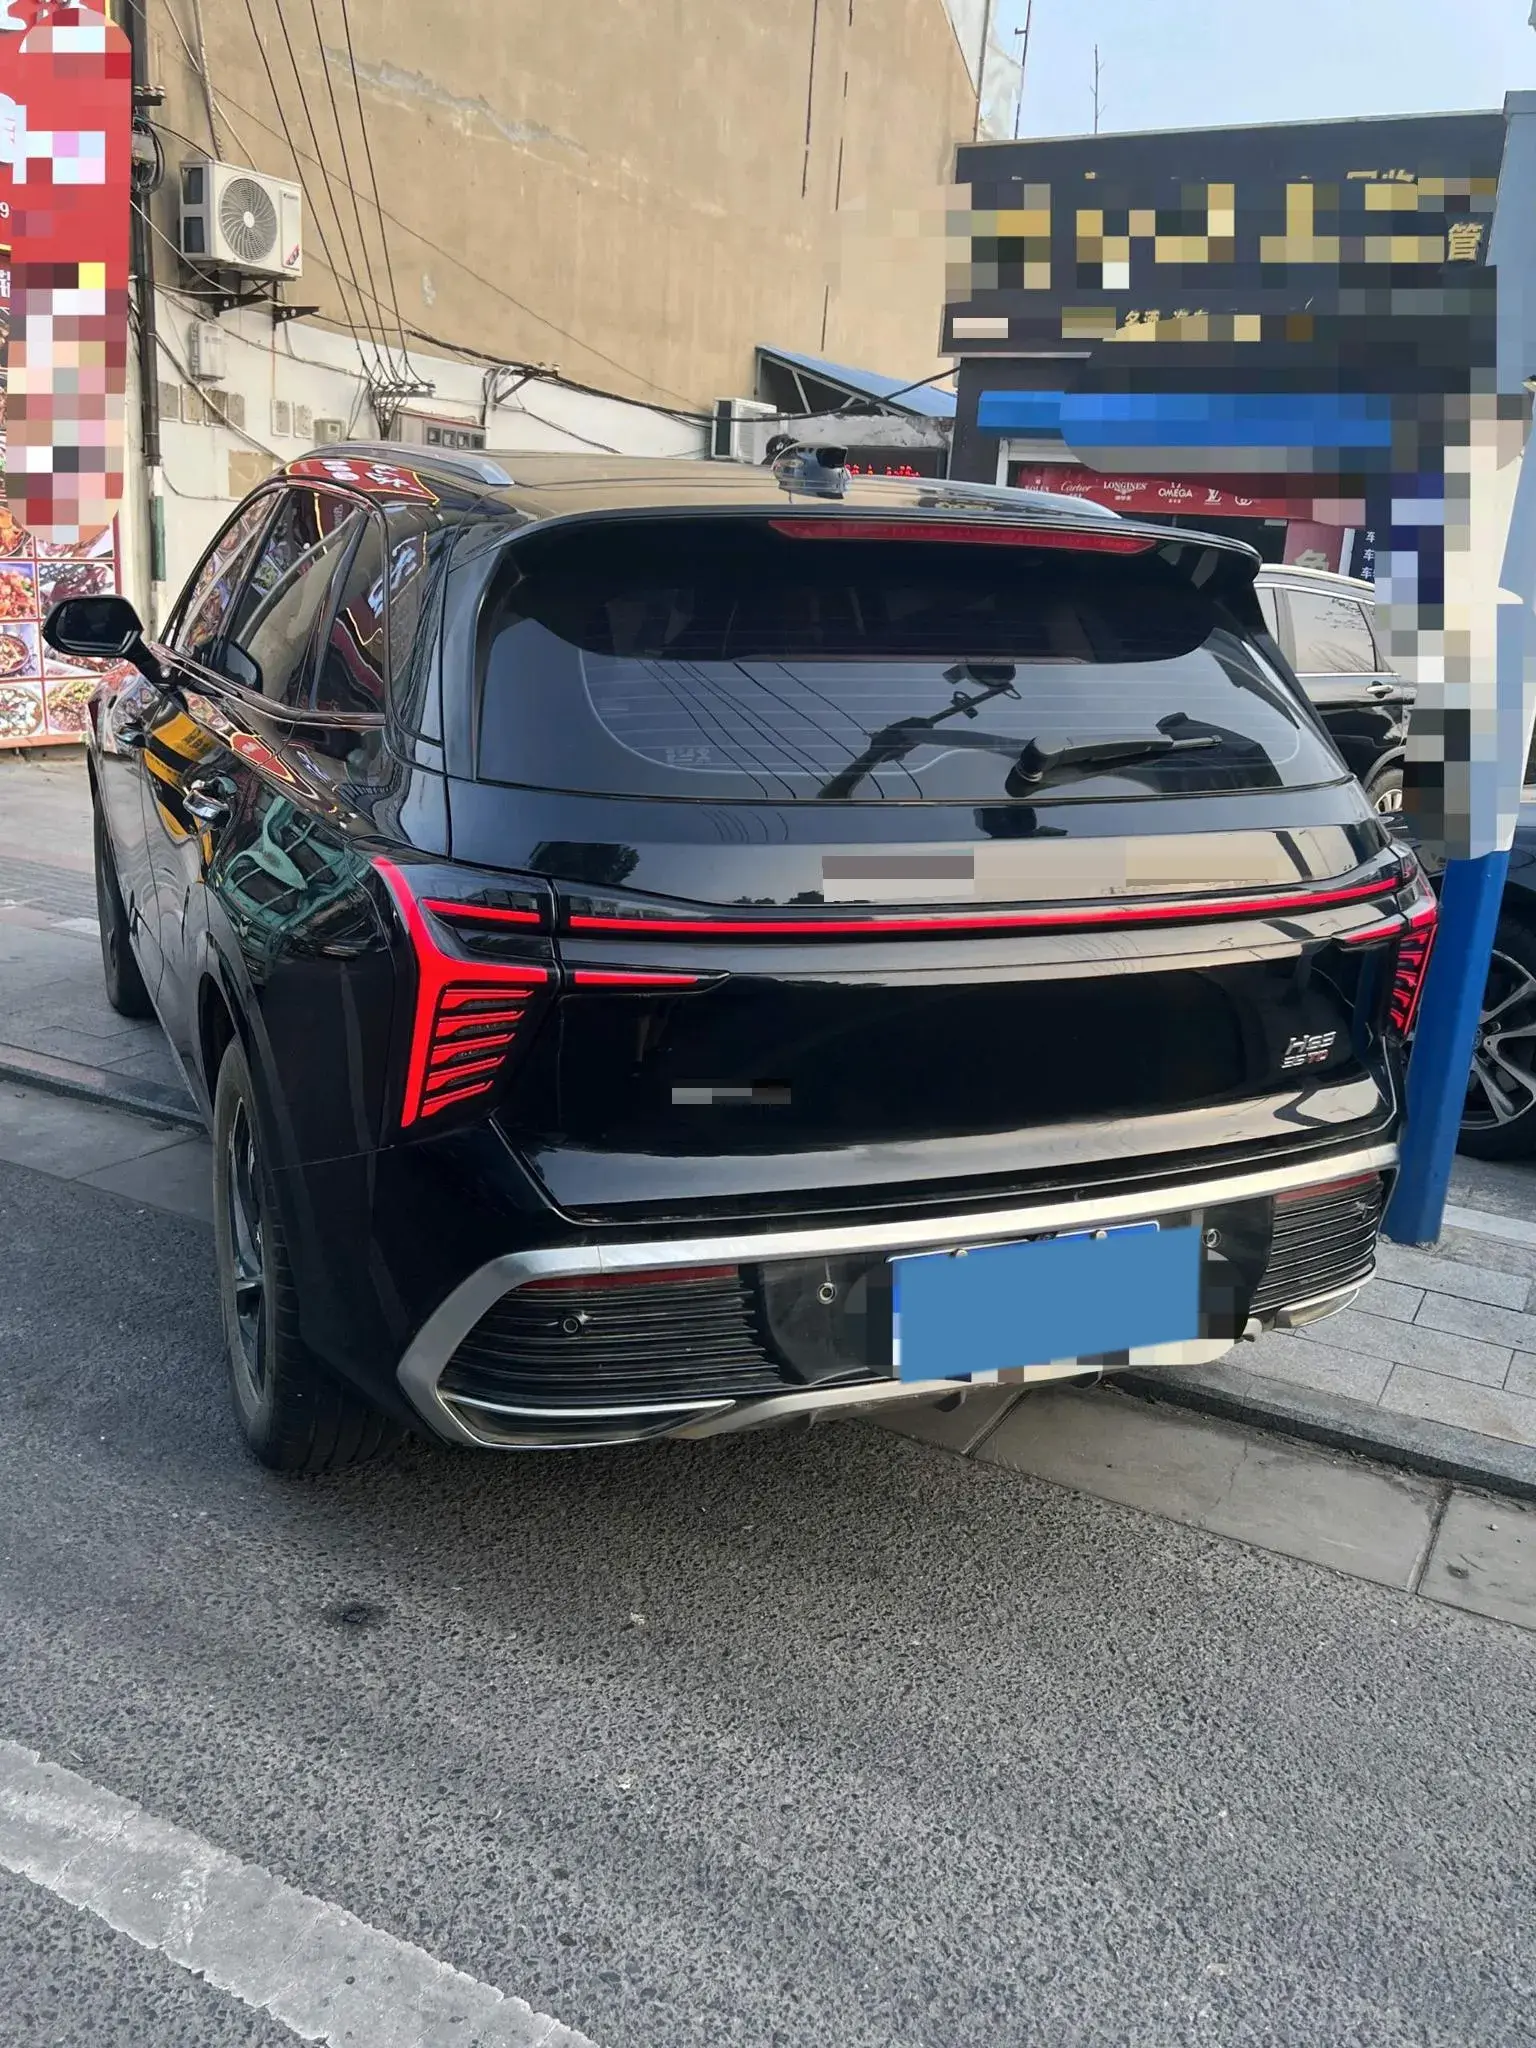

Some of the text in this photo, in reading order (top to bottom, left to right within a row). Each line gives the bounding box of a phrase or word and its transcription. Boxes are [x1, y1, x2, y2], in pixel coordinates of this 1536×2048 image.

[1447, 224, 1483, 261] 管
[1060, 481, 1091, 492] Cartier
[1103, 481, 1147, 490] LONGINES
[1158, 488, 1193, 497] OMEGA
